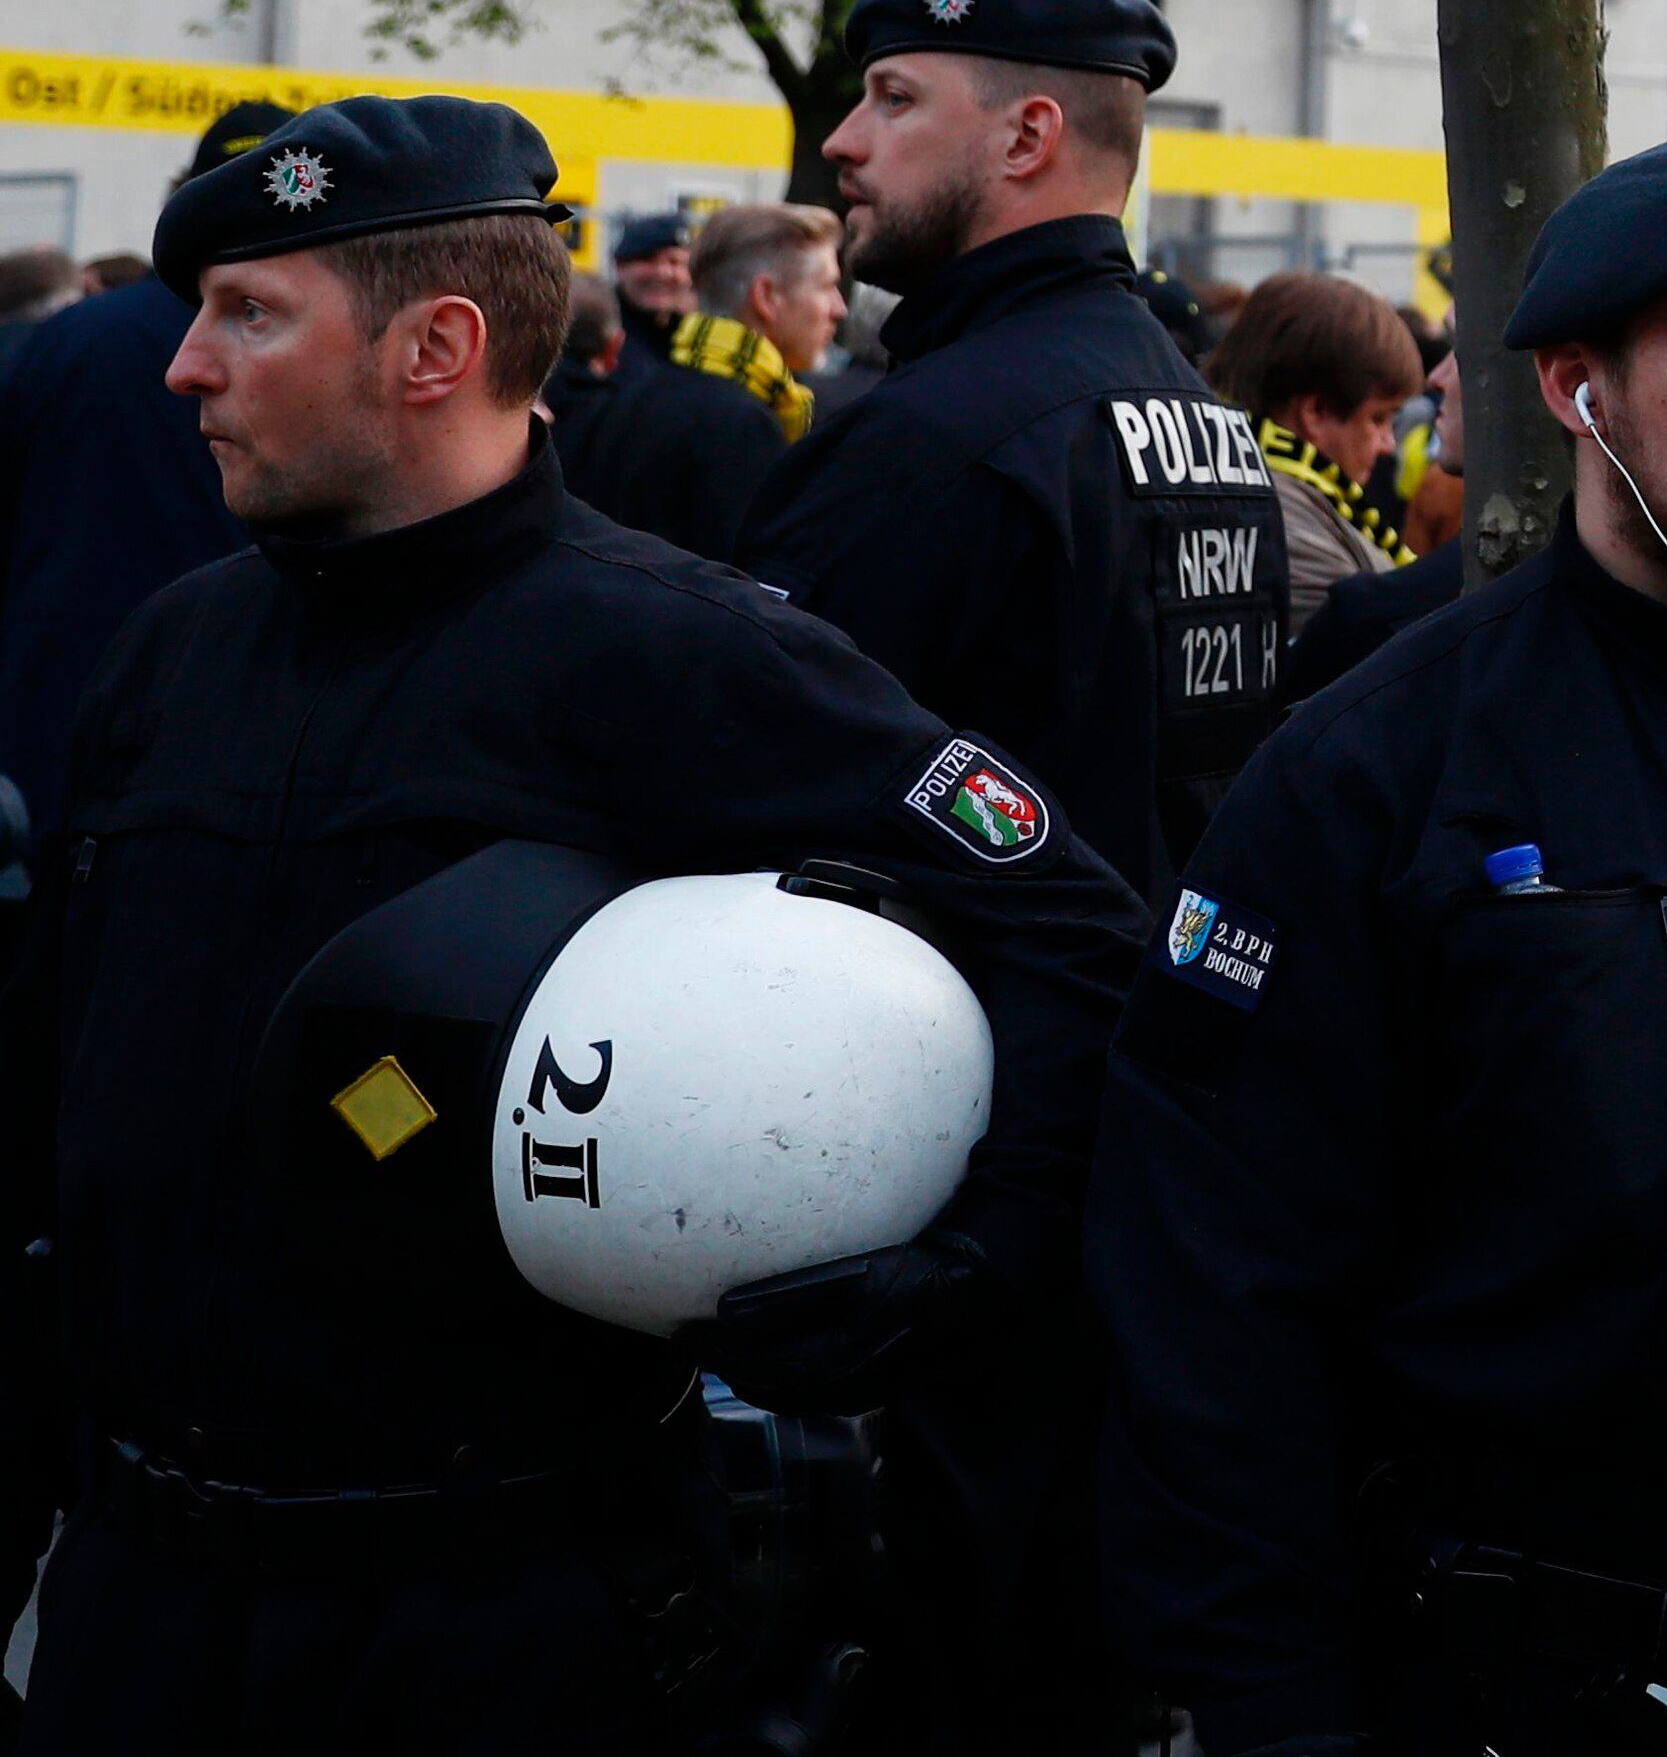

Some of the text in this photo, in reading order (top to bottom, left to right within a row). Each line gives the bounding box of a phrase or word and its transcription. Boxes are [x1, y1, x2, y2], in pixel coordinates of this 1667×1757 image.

[6, 66, 80, 109] Ost
[1177, 526, 1258, 599] NRW
[1181, 623, 1243, 697] 1221
[913, 742, 978, 812] POLIZEI
[1203, 946, 1266, 991] BOCHUM
